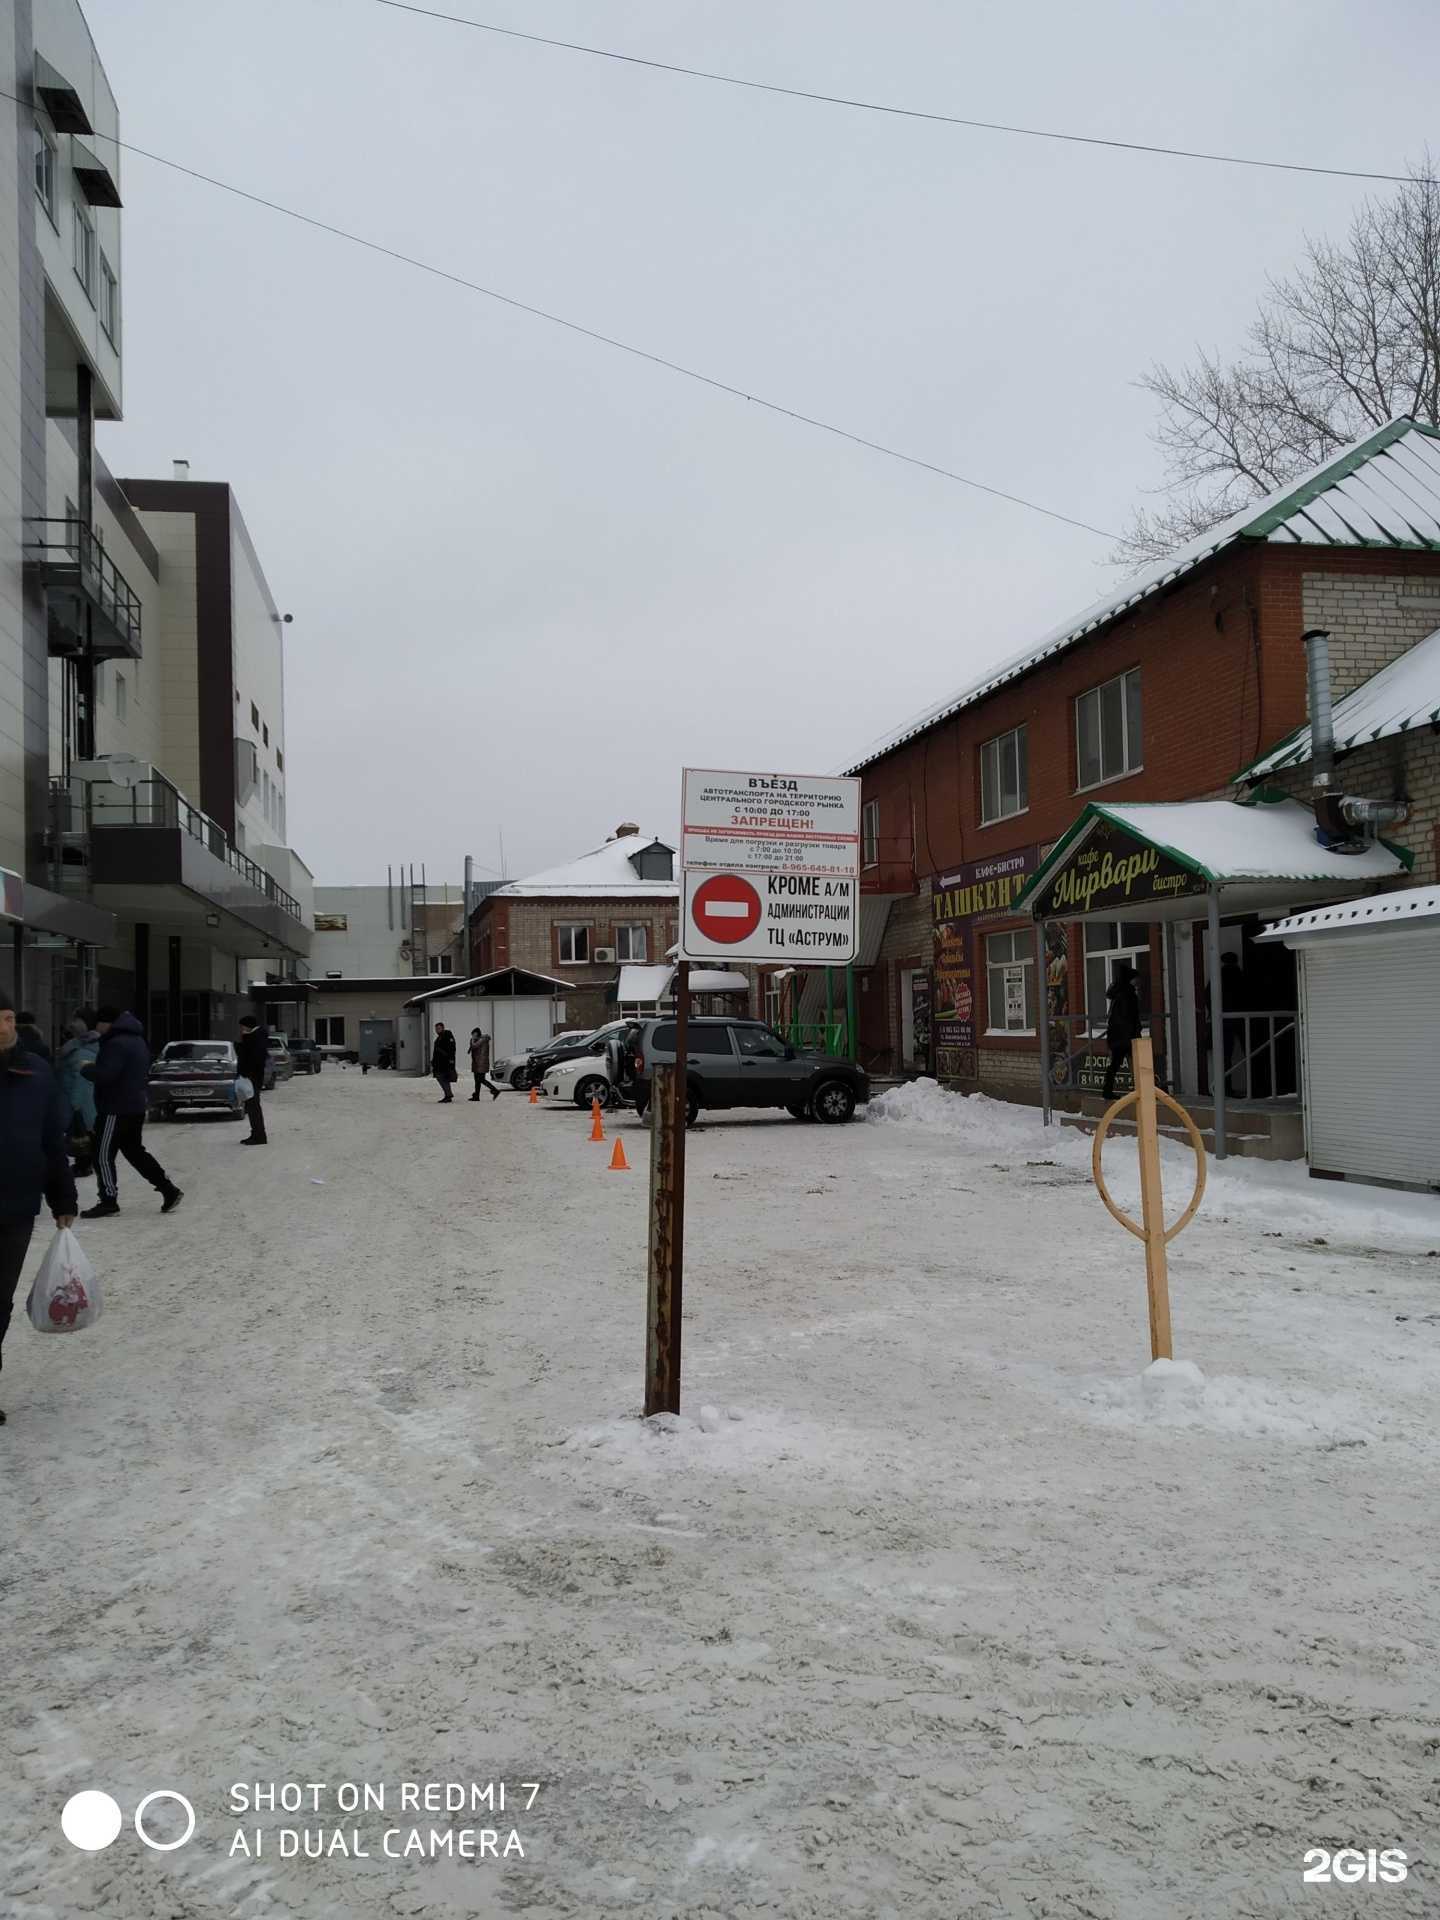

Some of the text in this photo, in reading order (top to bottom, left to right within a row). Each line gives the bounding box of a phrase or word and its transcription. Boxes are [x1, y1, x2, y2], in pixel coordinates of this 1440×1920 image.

[704, 788, 775, 798] АВТОТРАНСПОРТА
[789, 793, 842, 801] ТЕРРИТОРИЮ
[749, 778, 798, 792] ВЪЕЗД
[700, 795, 763, 805] ЦЕНТРАЛЬНОГО
[764, 799, 815, 808] ГОРОДСКОГО
[744, 807, 768, 815] 10:00
[770, 808, 784, 816] ДО
[786, 809, 811, 817] 17:00
[731, 815, 814, 830] ЗАПРЕЩЕН!
[975, 856, 1025, 879] КАФЕ-БИСТРО
[1077, 848, 1100, 870] кафе
[768, 876, 850, 897] КРОМЕ А/М
[1052, 848, 1160, 912] Мирвари
[1152, 873, 1187, 897] бистро
[933, 873, 1025, 920] ТАШКЕНТ
[767, 903, 850, 922] АДМИНИСТРАЦИИ
[768, 928, 785, 946] ТЦ
